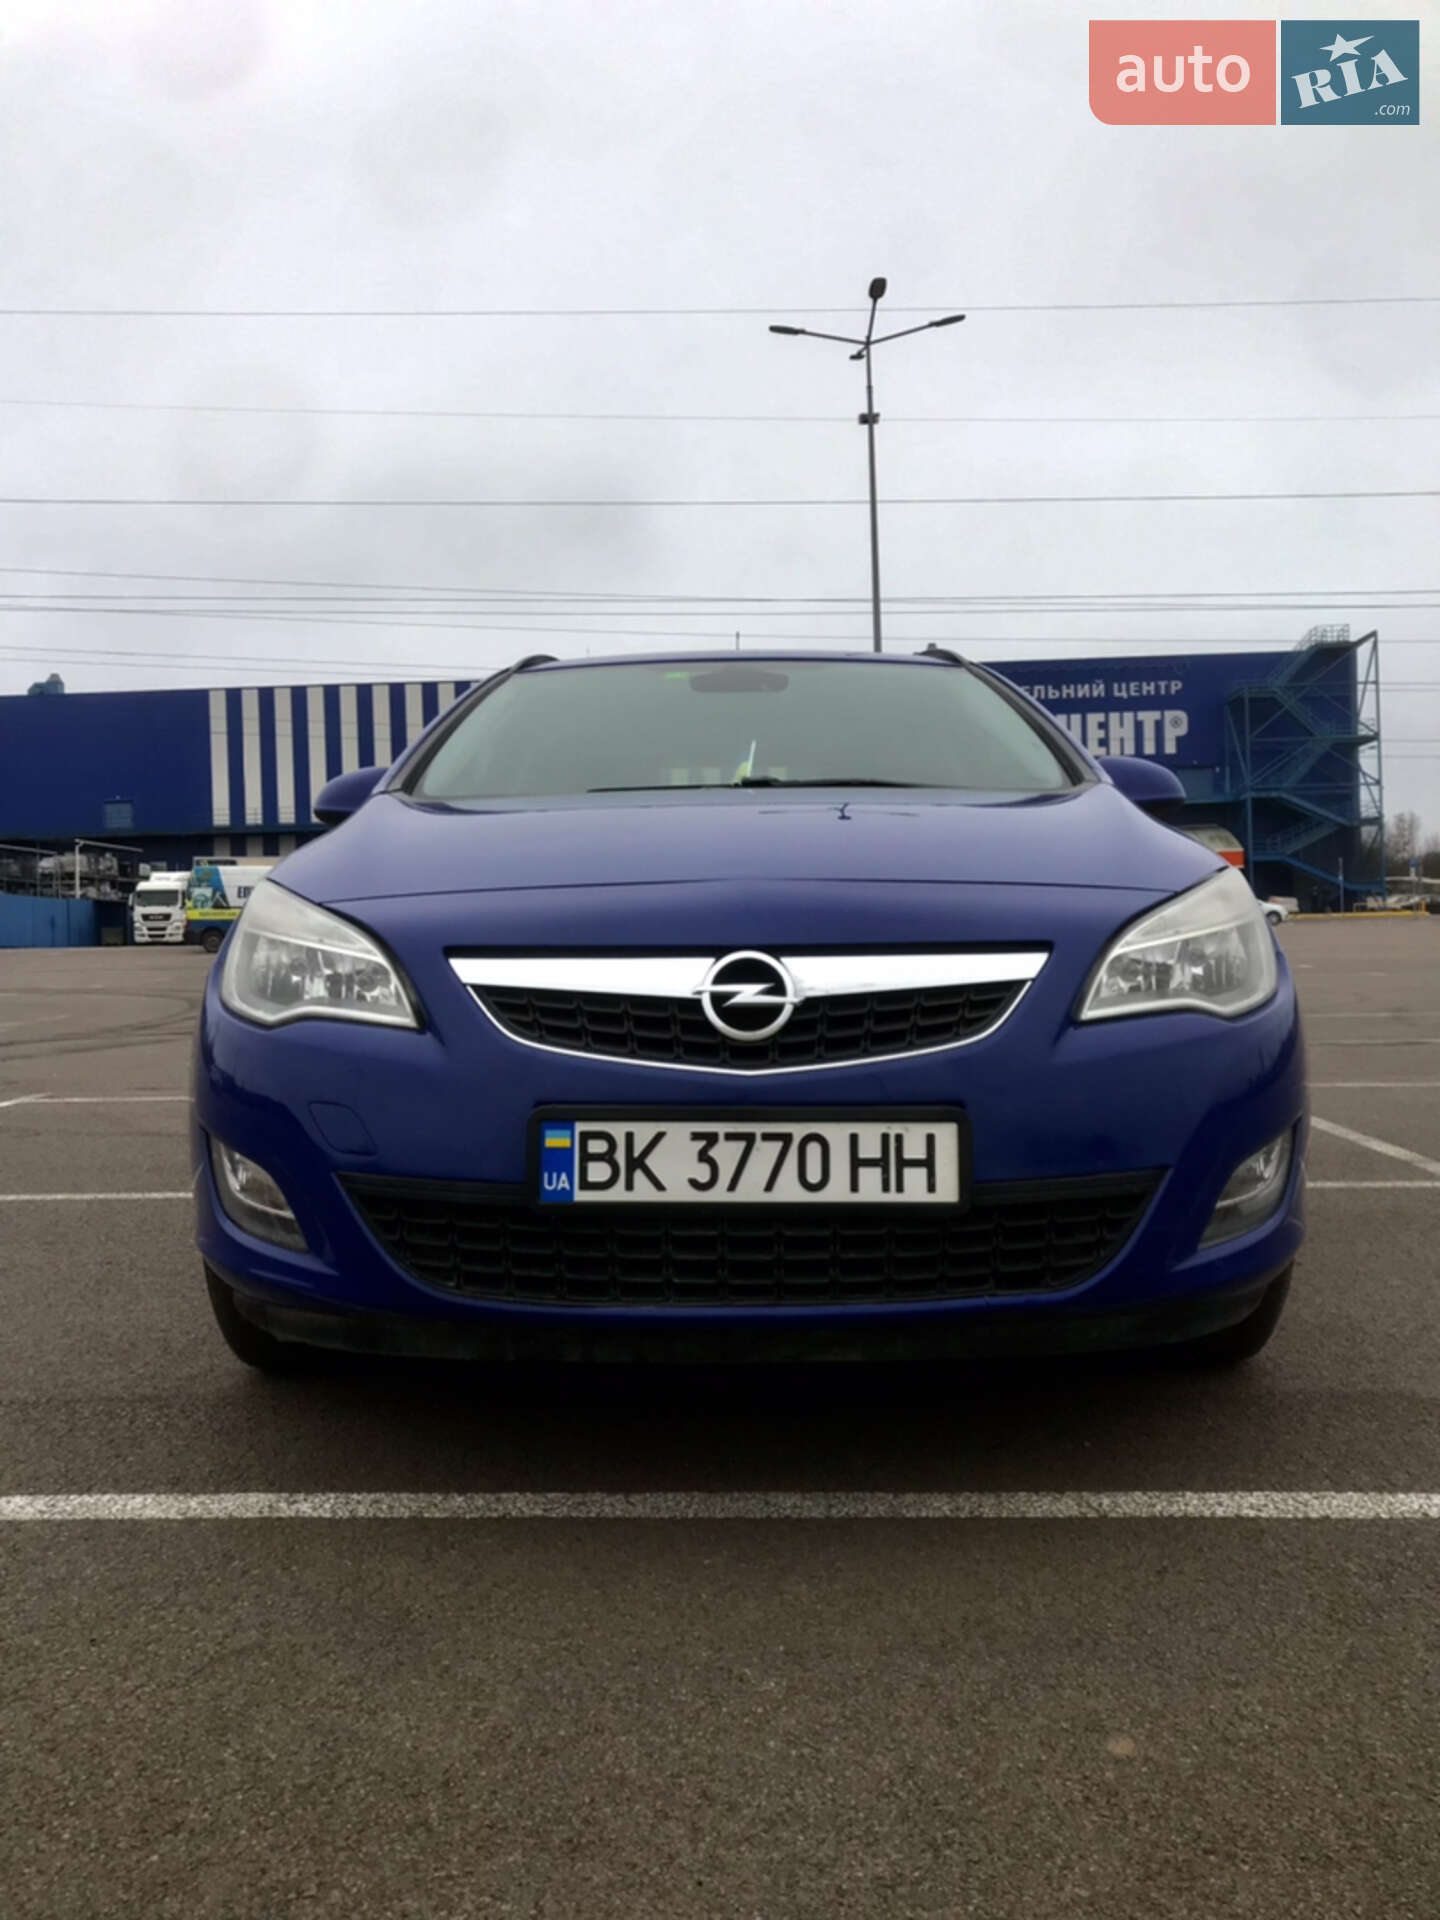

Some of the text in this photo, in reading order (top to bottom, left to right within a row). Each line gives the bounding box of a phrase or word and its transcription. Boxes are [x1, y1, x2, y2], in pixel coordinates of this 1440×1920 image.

[1112, 680, 1183, 699] ЦЕНТР
[577, 1130, 937, 1194] BK 3770 HH
[543, 1171, 571, 1192] UA
